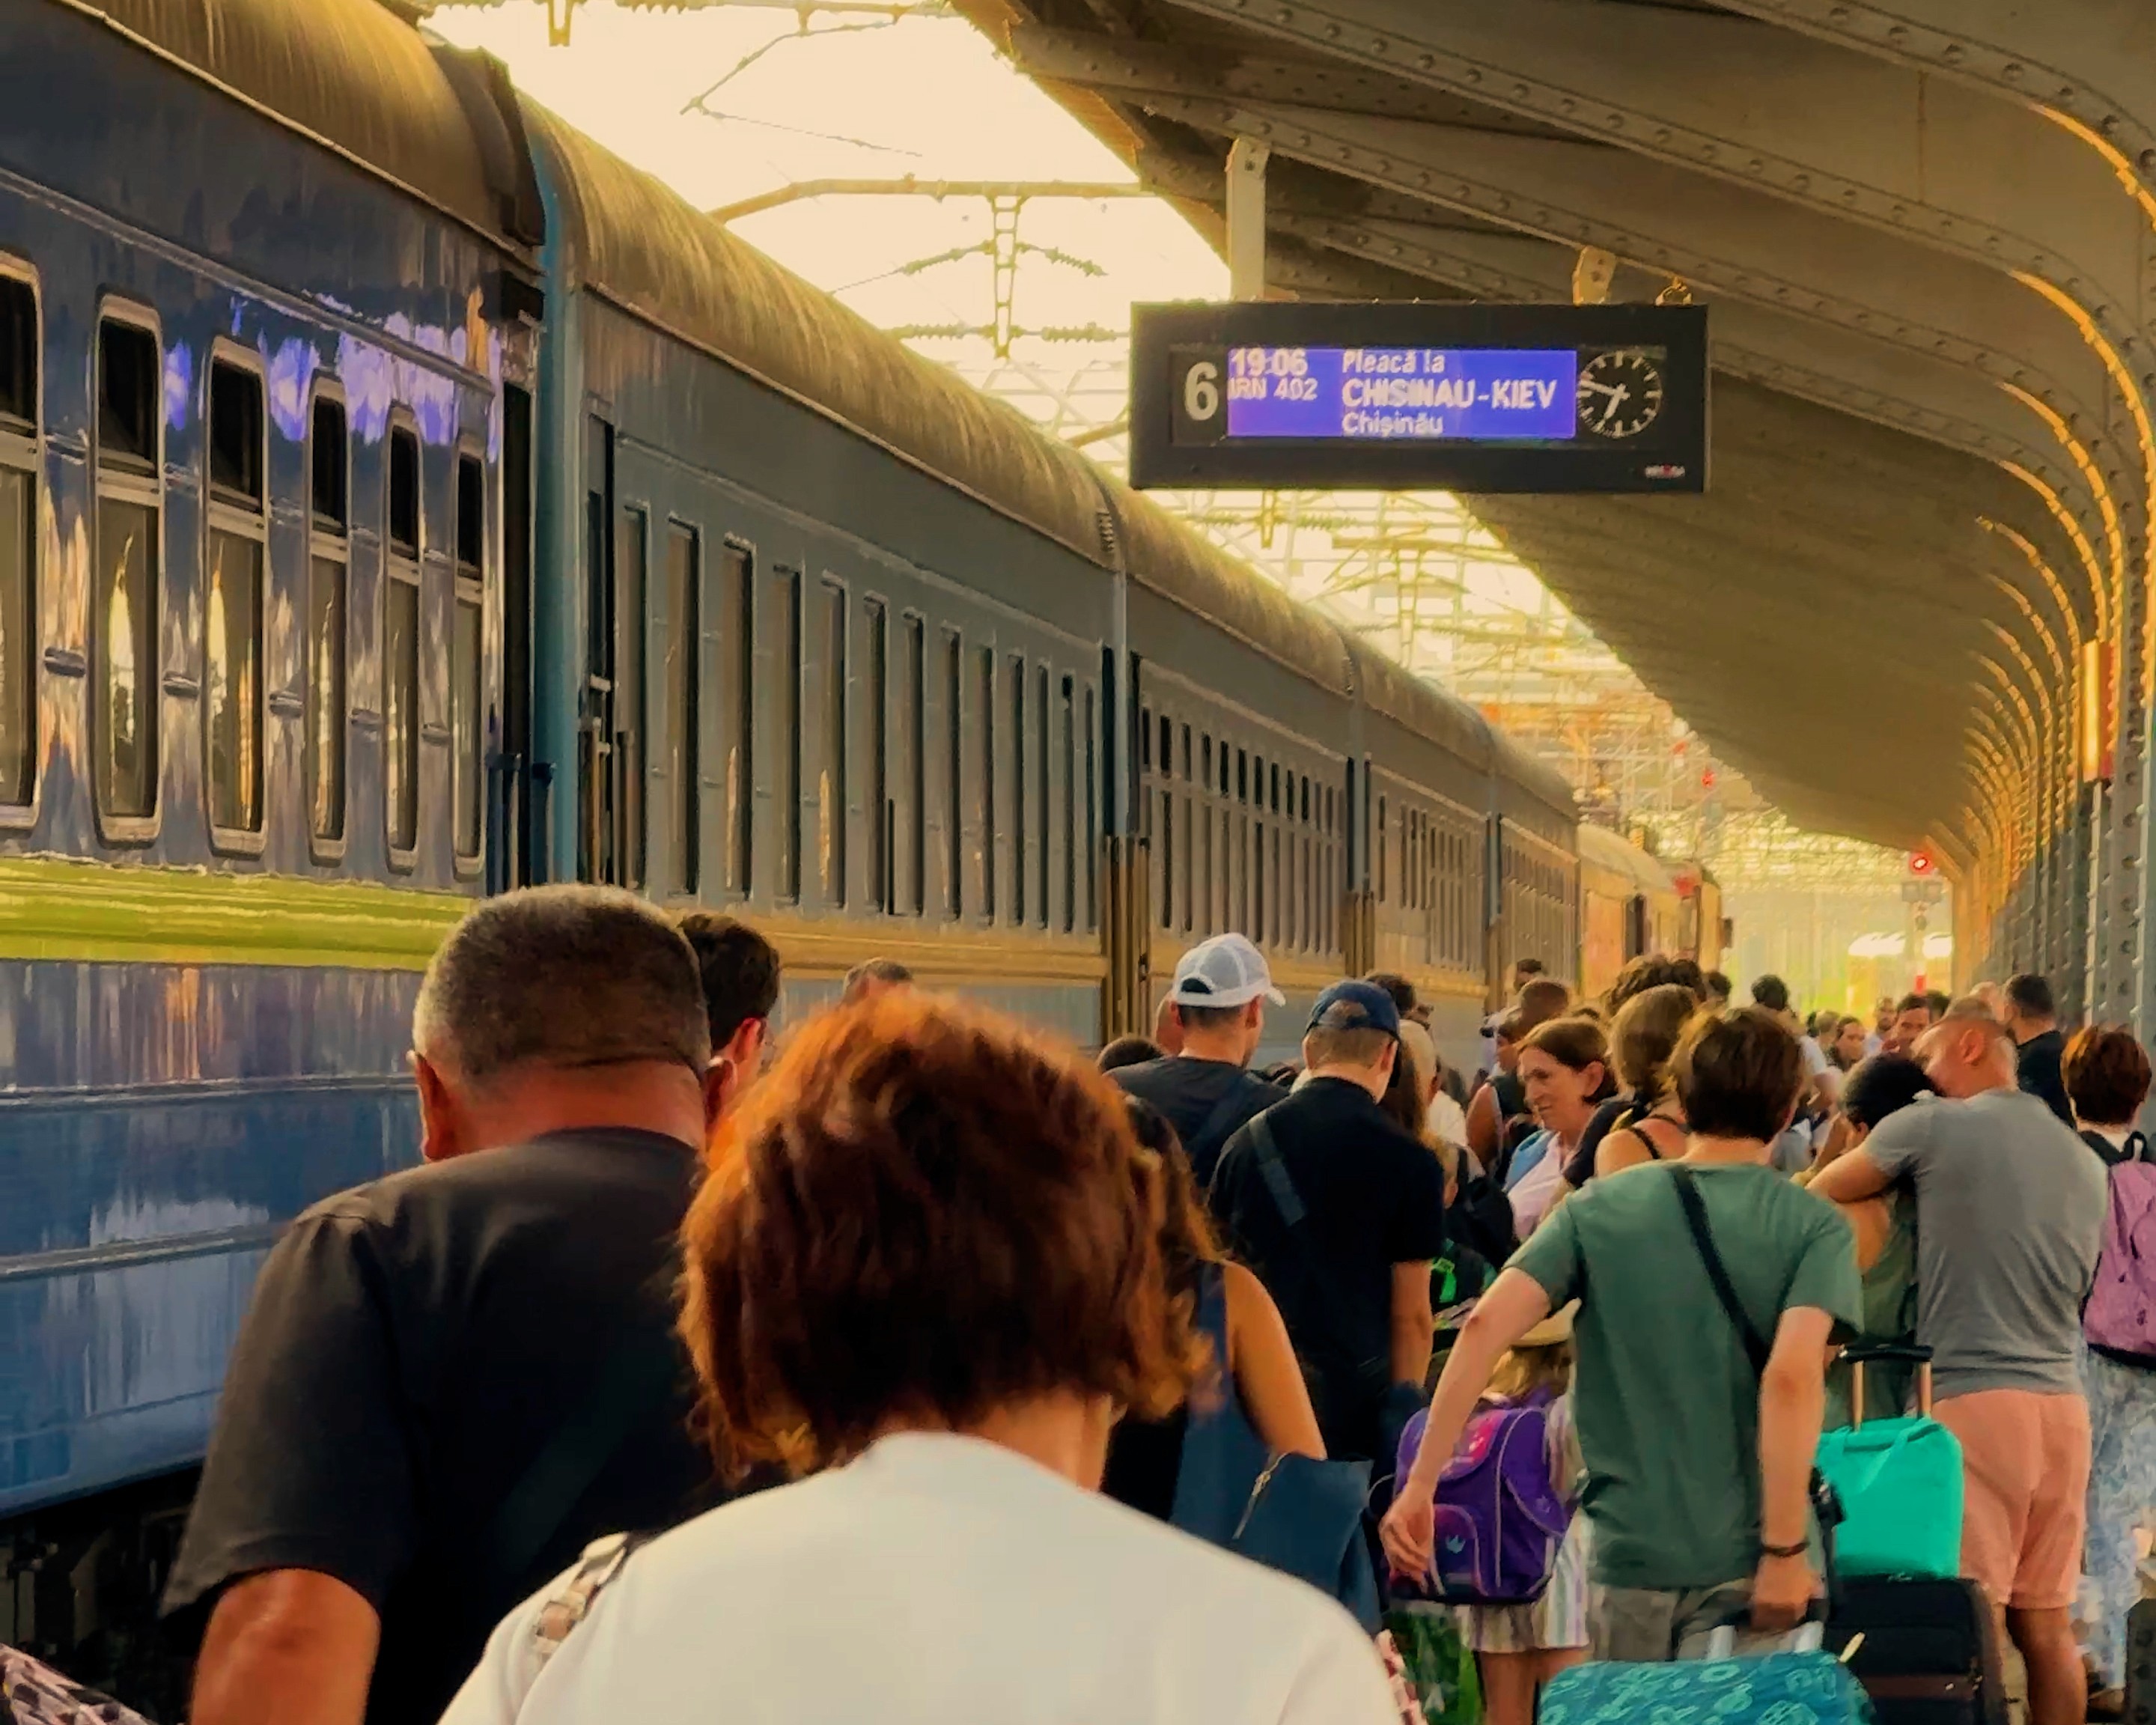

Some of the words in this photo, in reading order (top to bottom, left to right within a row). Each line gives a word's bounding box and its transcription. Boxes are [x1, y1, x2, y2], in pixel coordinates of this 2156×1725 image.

[1423, 348, 1446, 374] la
[1185, 362, 1219, 421] 6
[1273, 377, 1318, 401] 402
[1342, 378, 1557, 409] CHISINAU-KIEV
